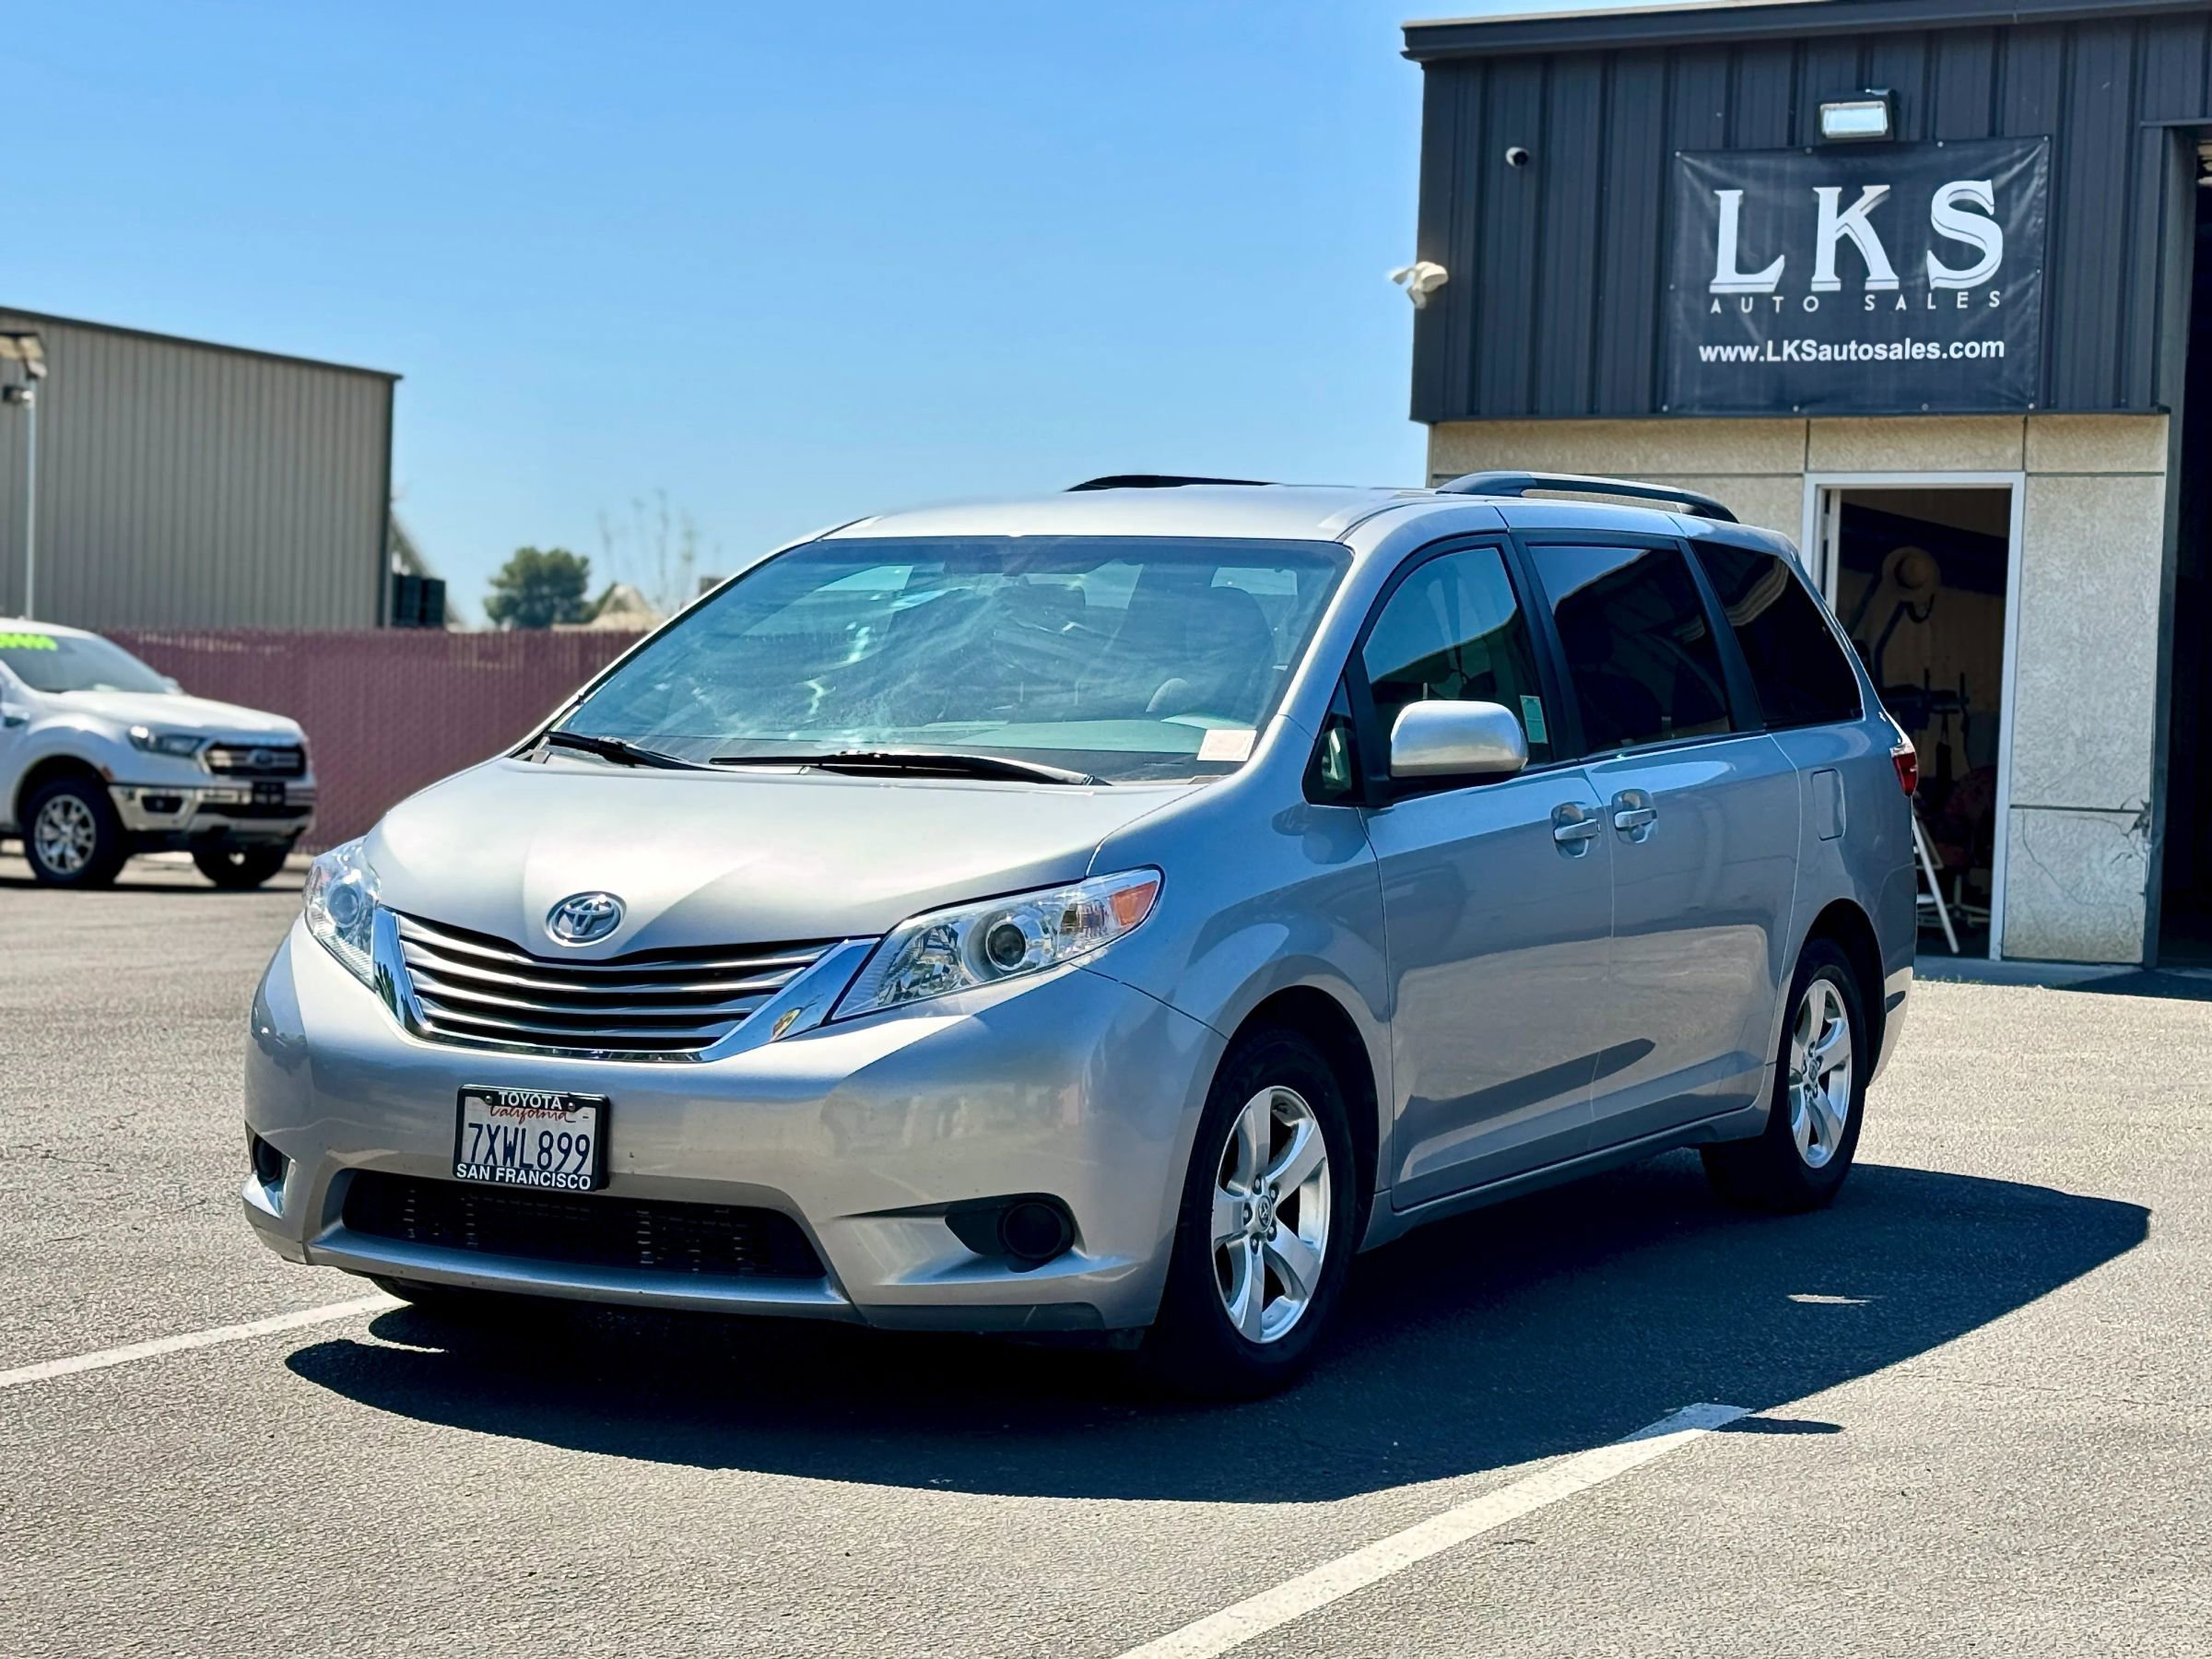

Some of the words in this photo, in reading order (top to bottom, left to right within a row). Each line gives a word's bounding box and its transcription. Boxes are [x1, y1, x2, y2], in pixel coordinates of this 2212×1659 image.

[1709, 179, 2004, 293] LKS
[1710, 294, 1819, 314] AUTO
[1864, 290, 2001, 312] SALES
[1699, 337, 2005, 362] www.LKSautosales.com
[498, 1090, 563, 1111] TOYOTA
[468, 1122, 591, 1175] 7XWL899
[456, 1163, 490, 1182] SAN
[495, 1167, 591, 1190] FRANCISCO
